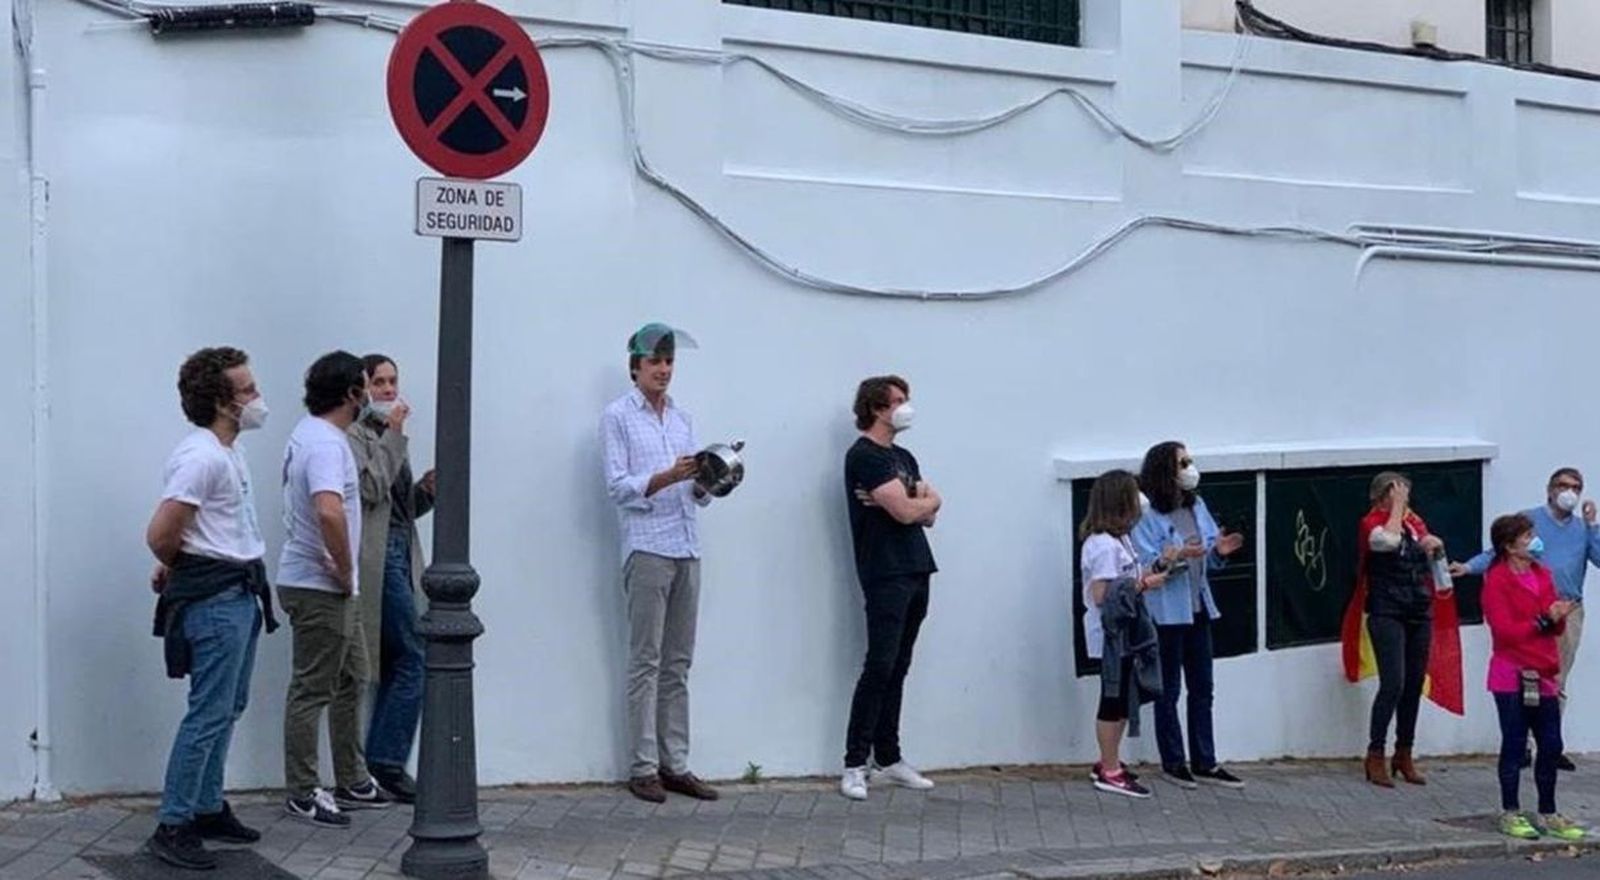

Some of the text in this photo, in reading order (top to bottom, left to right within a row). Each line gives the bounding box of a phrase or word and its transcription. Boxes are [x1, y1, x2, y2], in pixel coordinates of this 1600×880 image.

[436, 187, 504, 207] ZONA DE
[426, 211, 514, 232] SEGURIDAD
